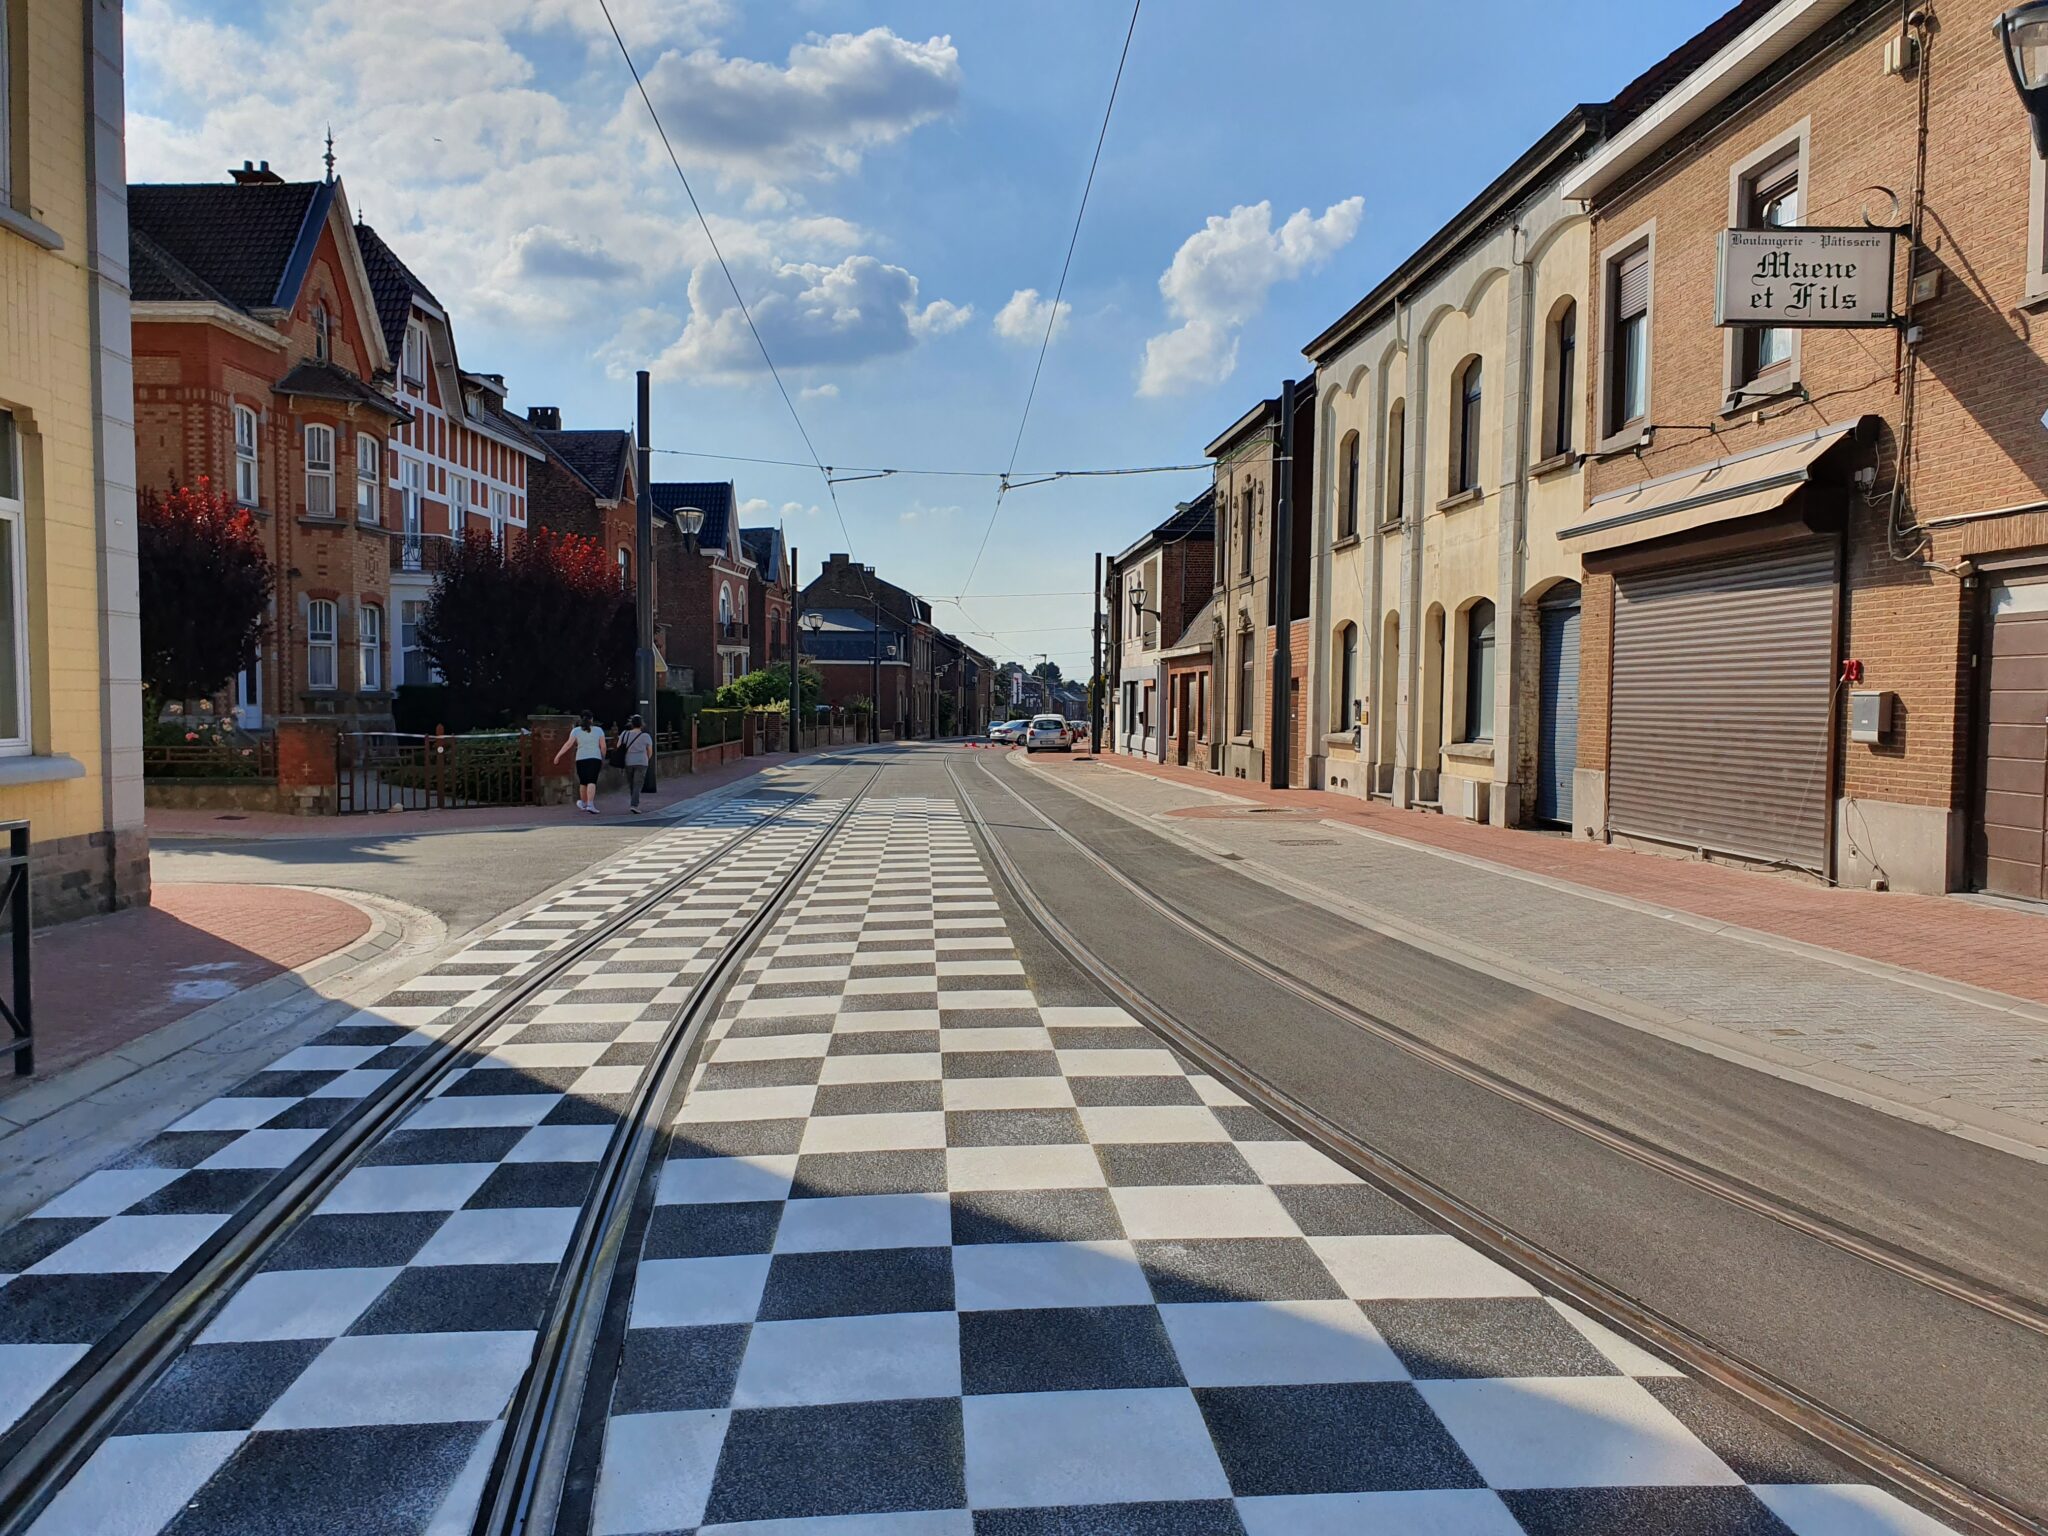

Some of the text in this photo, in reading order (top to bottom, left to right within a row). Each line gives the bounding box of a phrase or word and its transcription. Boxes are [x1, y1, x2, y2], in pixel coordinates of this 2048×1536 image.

[1731, 233, 1803, 248] Boulangerie
[1820, 235, 1881, 248] Pâtisserie
[1751, 251, 1857, 286] Maene
[1750, 282, 1857, 317] et Fils
[1842, 659, 1859, 681] 73
